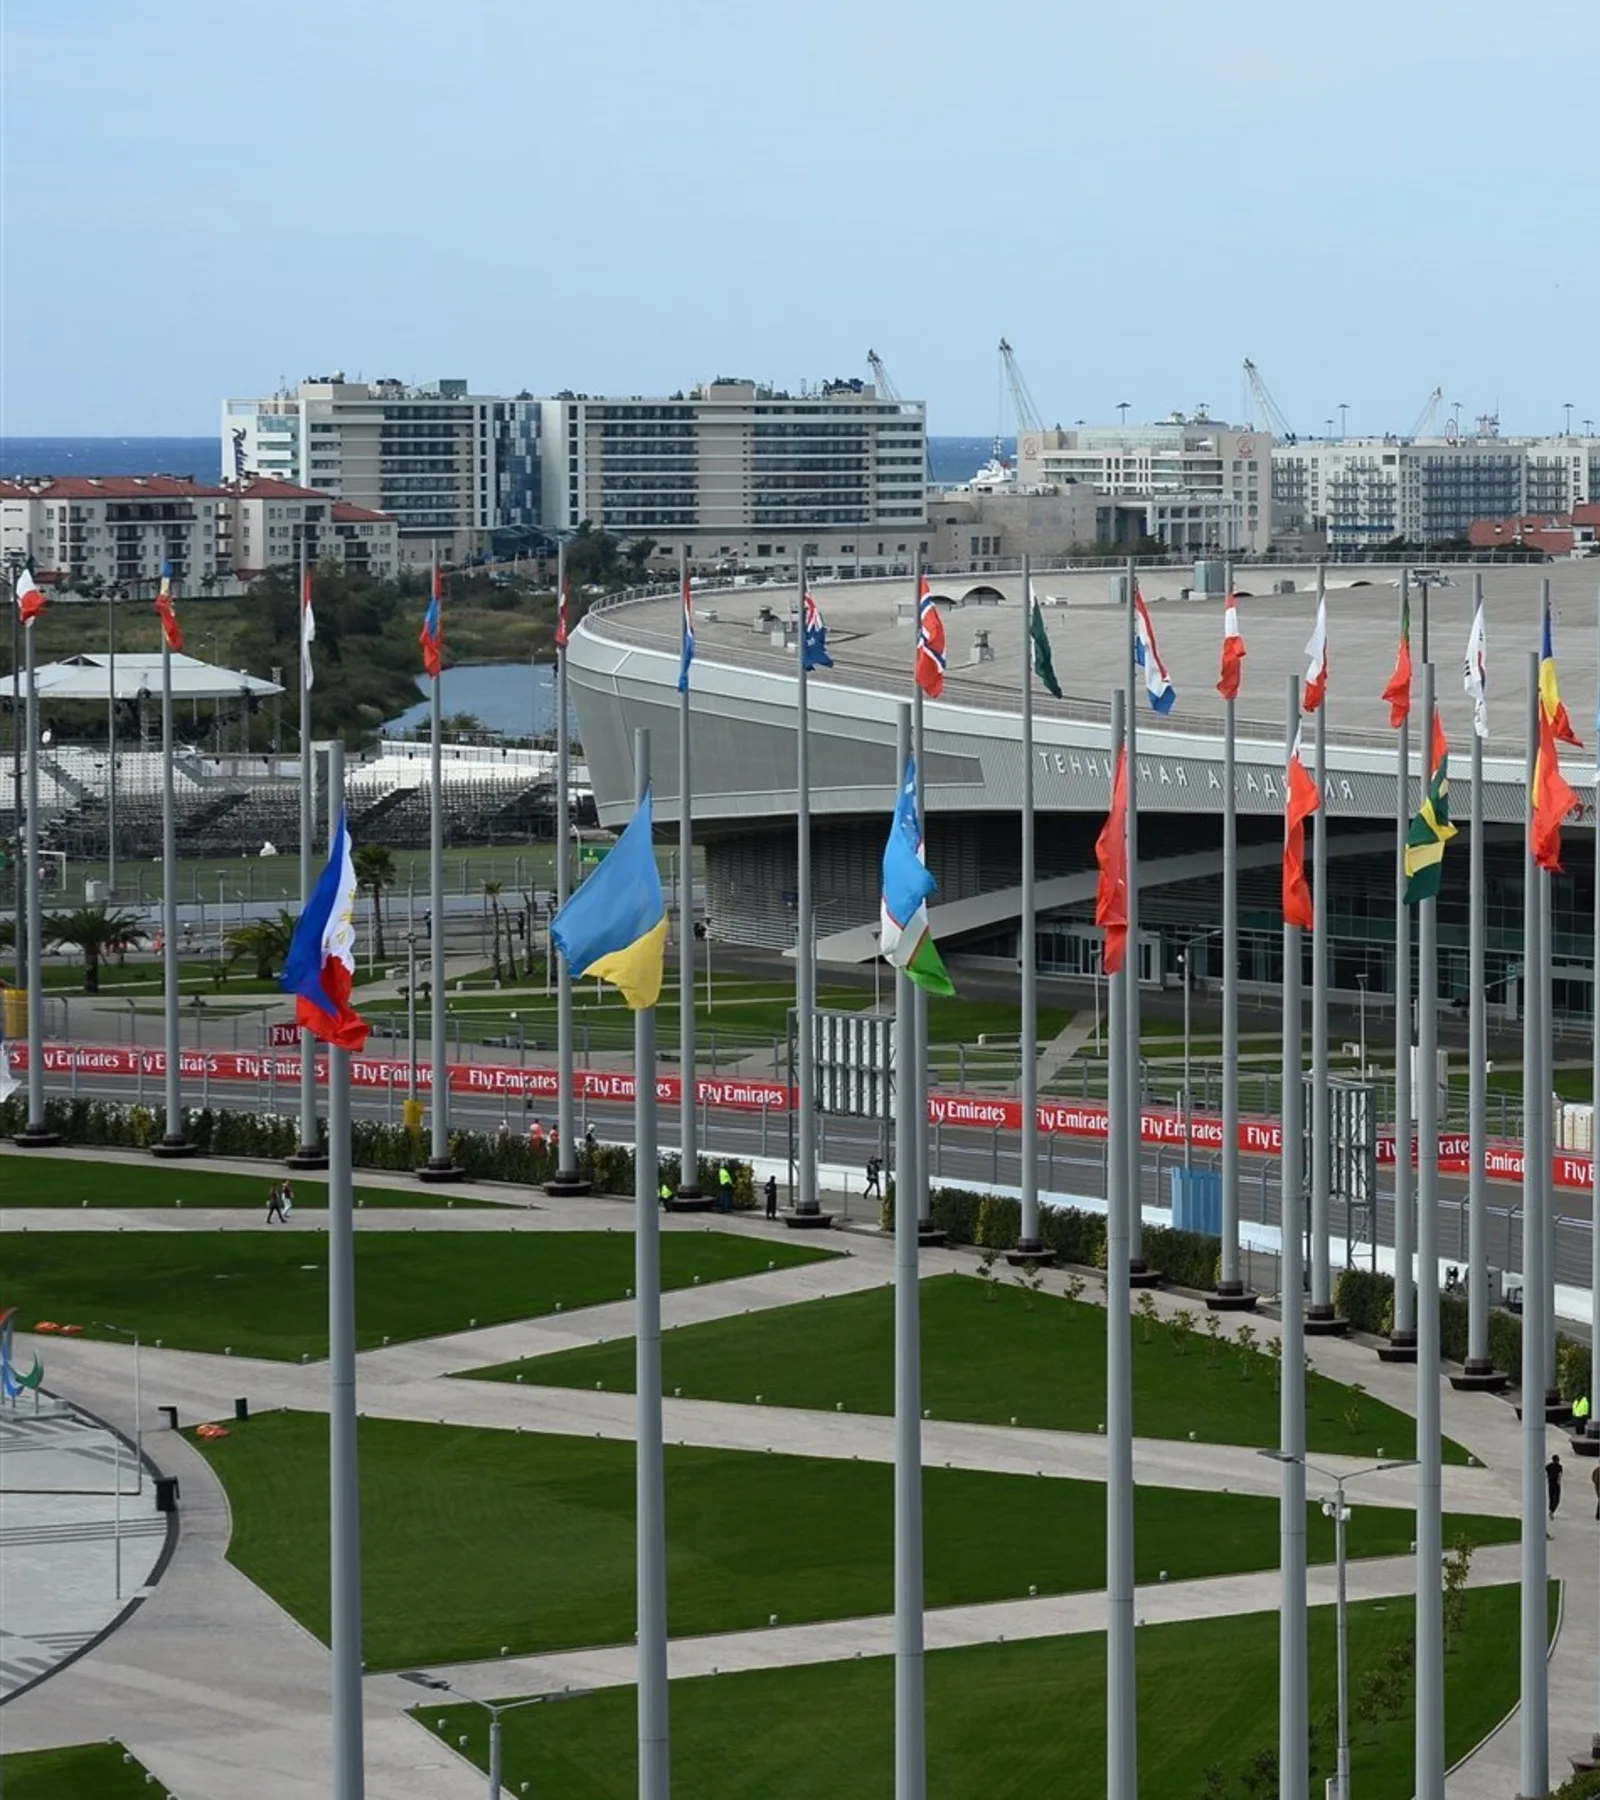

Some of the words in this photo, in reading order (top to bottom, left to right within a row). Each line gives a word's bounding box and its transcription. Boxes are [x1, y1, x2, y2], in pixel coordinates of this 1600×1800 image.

[1039, 752, 1188, 786] ТЕНННАЯ
[128, 1053, 153, 1072] Fy
[353, 1063, 377, 1084] Fly
[469, 1070, 493, 1090] Fly
[585, 1076, 609, 1096] Fly
[611, 1078, 672, 1097] Emes
[698, 1083, 722, 1103] Fly
[724, 1085, 784, 1104] Emirates
[928, 1100, 945, 1119] ly
[947, 1101, 1006, 1121] Emirates
[1056, 1110, 1108, 1130] Emirate
[1141, 1117, 1163, 1139] Fly
[1165, 1119, 1222, 1141] Emrates
[1247, 1127, 1270, 1149] Fly
[1564, 1161, 1586, 1184] Fly
